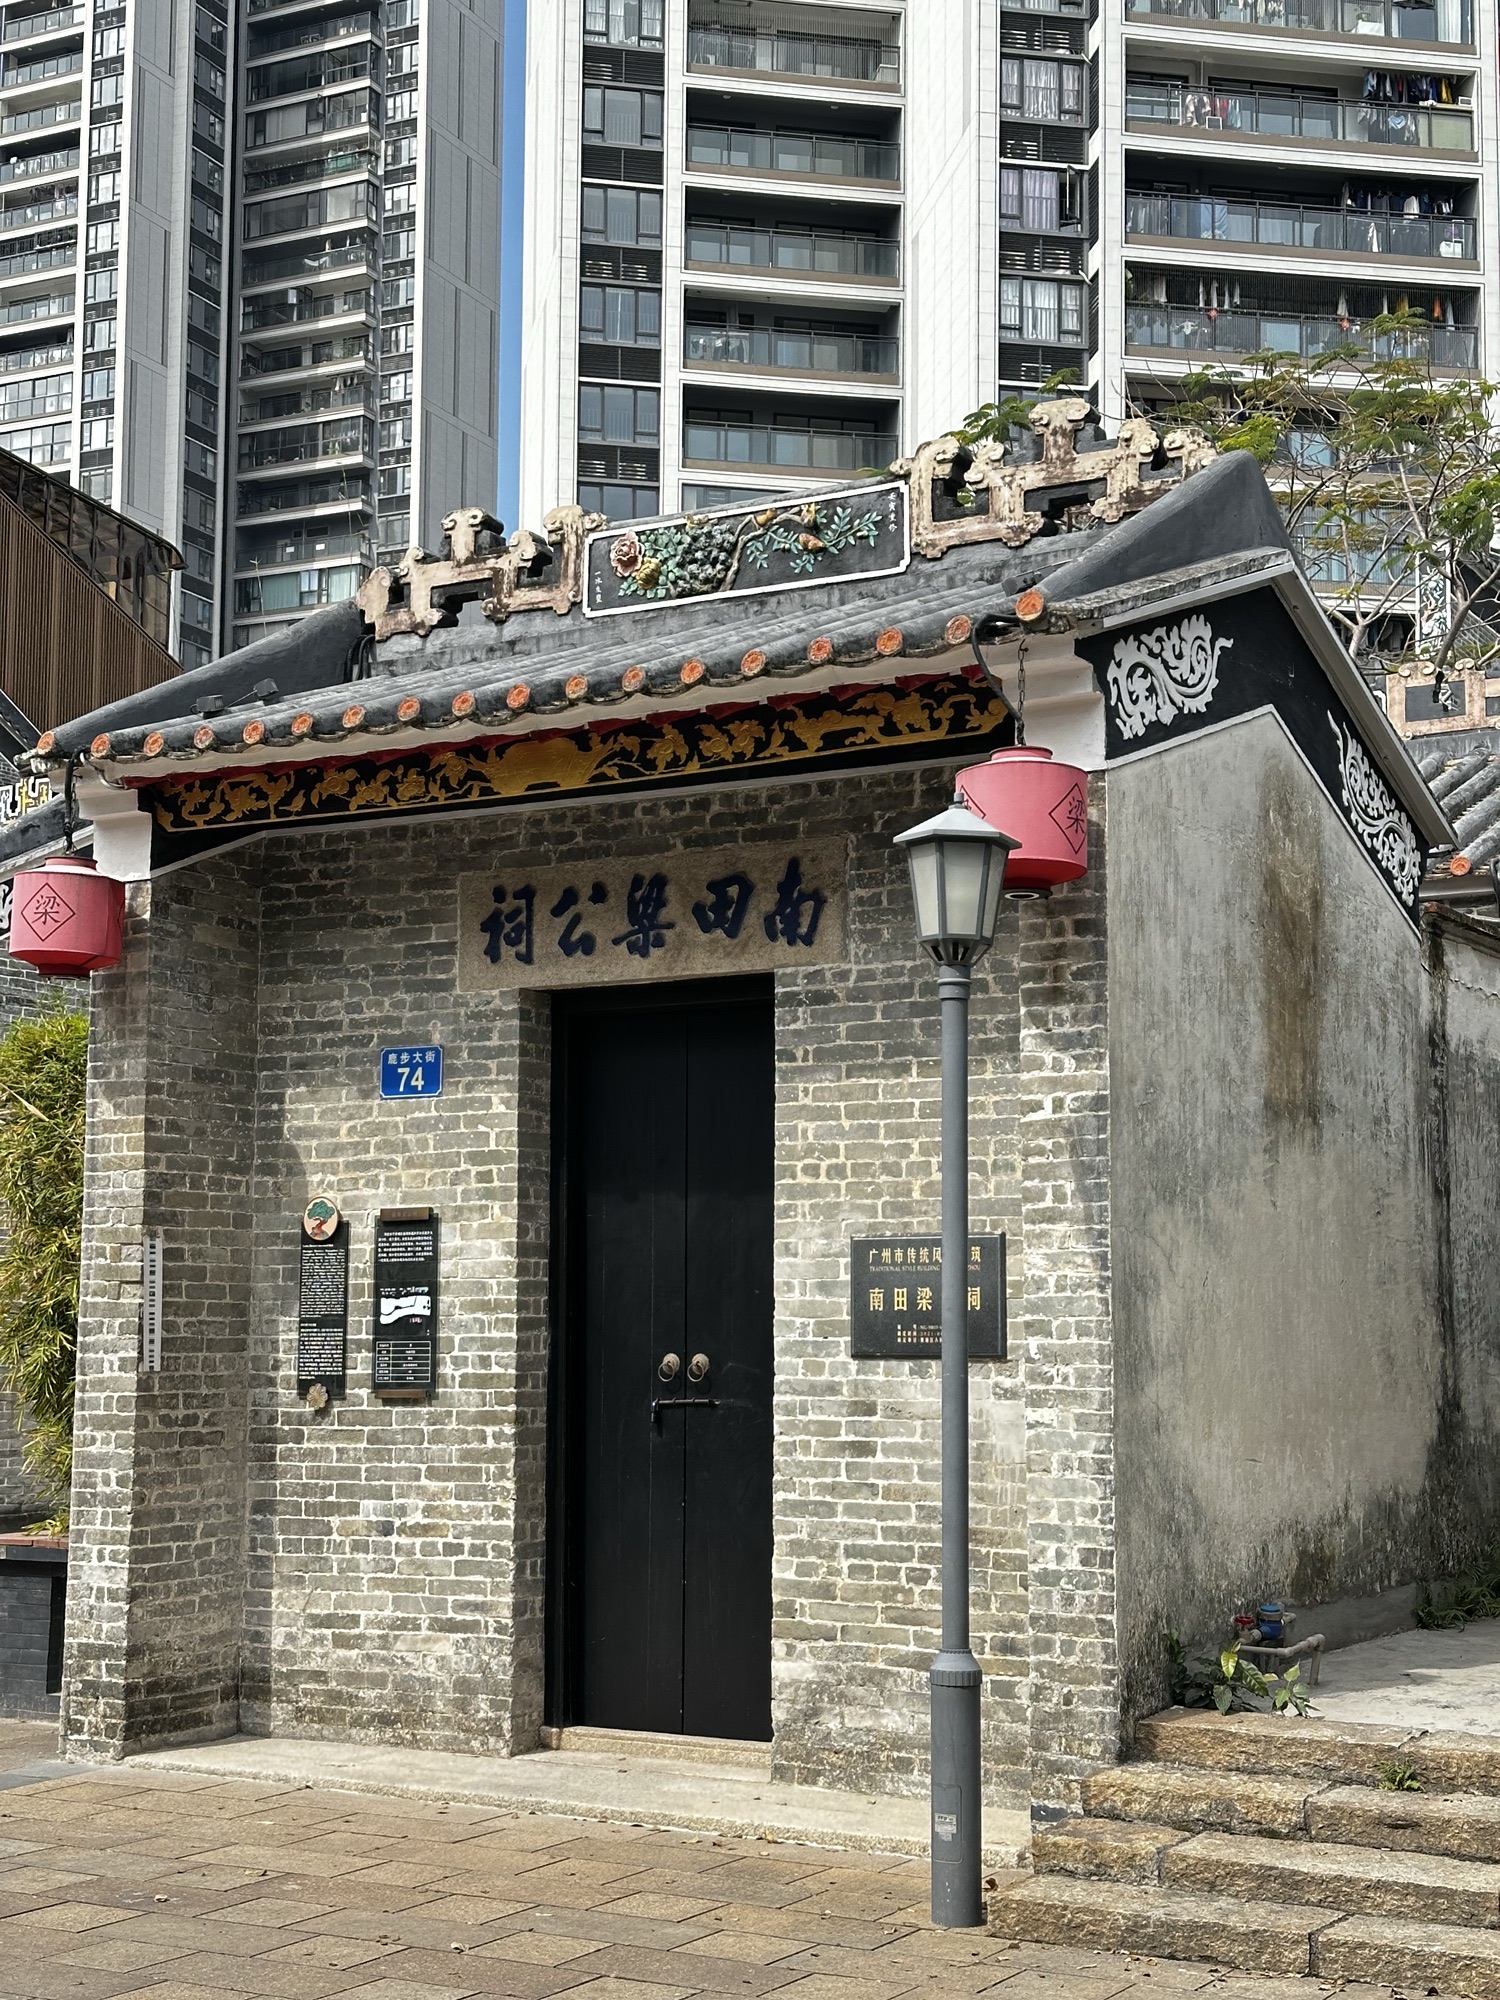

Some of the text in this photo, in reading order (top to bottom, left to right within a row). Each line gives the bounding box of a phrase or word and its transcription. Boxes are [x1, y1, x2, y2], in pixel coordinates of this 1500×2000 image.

[1064, 796, 1085, 834] 梁
[31, 895, 61, 925] 梁
[387, 1050, 435, 1065] 鹿步大街
[397, 1066, 424, 1092] 74
[869, 1246, 981, 1264] 广州市传统风筑
[869, 1287, 981, 1311] 南田梁祠
